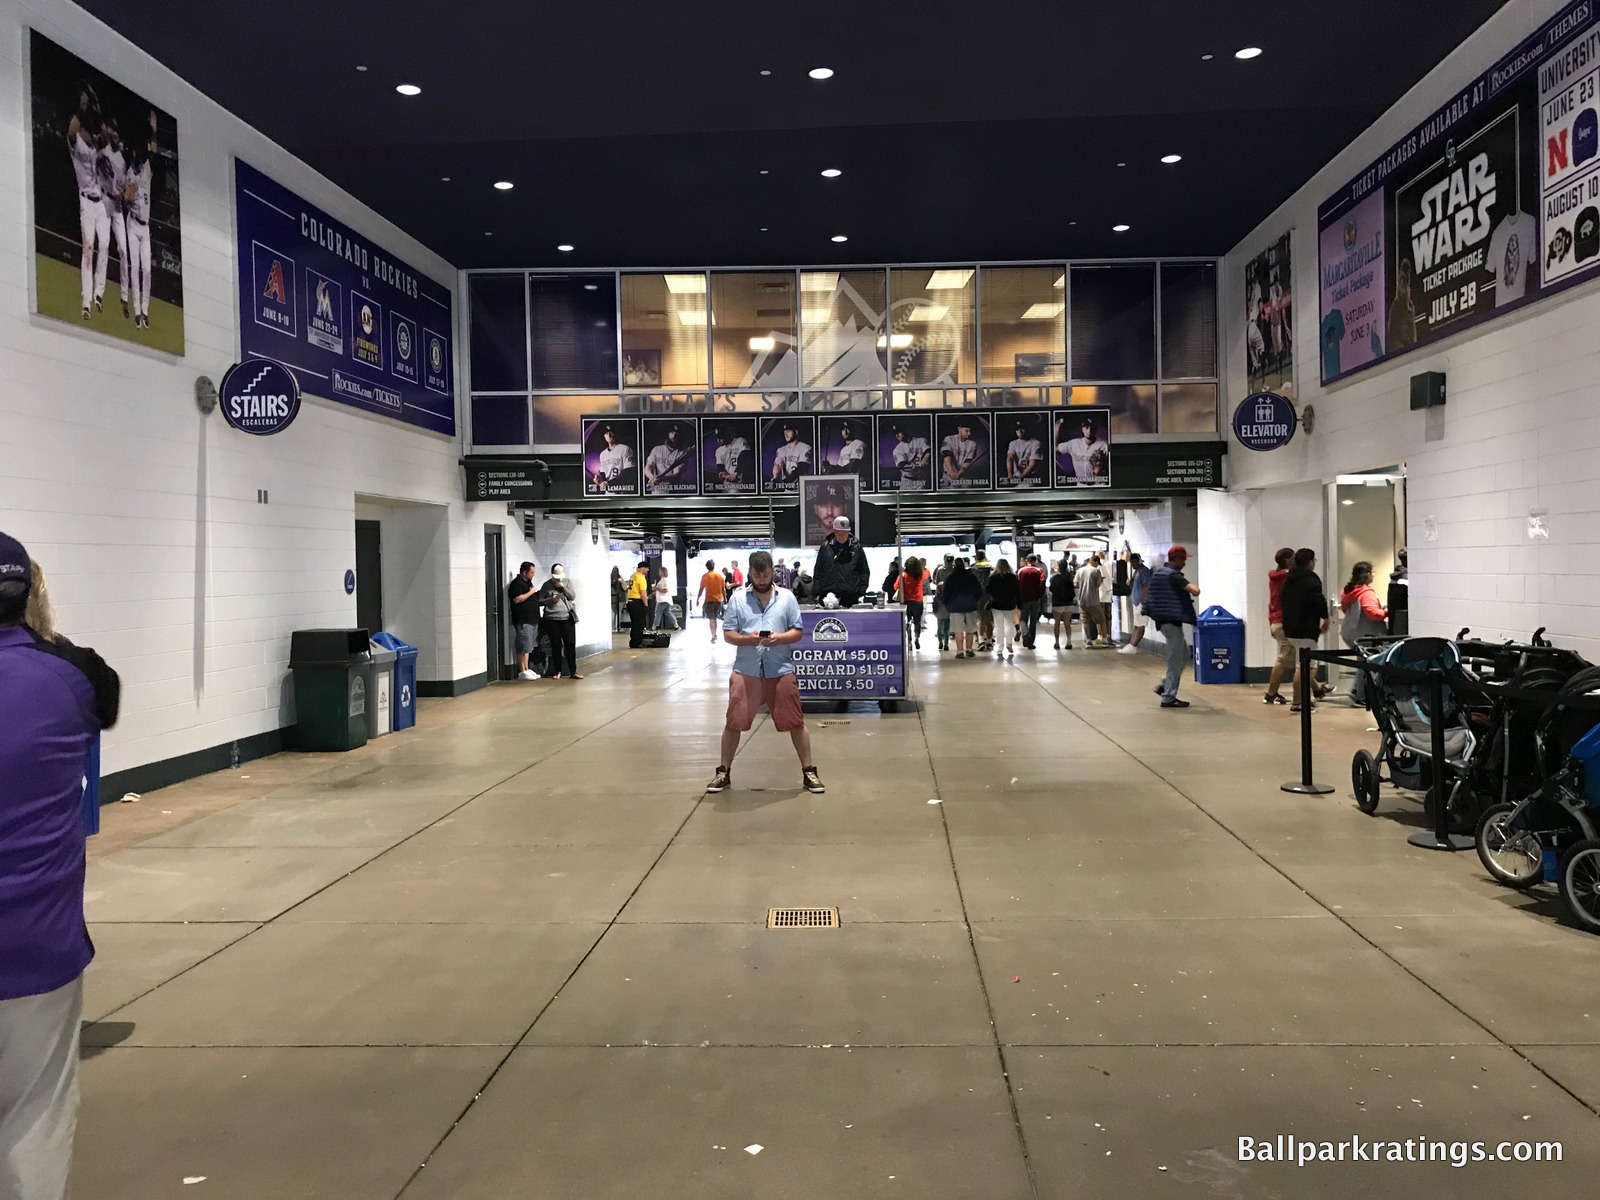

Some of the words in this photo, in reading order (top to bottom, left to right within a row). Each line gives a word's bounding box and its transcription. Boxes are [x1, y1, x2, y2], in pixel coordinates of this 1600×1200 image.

[1547, 90, 1574, 126] JUNE
[1580, 76, 1594, 104] 23
[1352, 169, 1375, 200] TICKET
[1378, 136, 1417, 180] PACKAGES
[1420, 94, 1469, 148] AVAILABLE
[1472, 81, 1485, 108] AT
[1412, 152, 1496, 238] STAR
[1546, 183, 1584, 222] AUGUST
[1588, 176, 1598, 200] 10
[1412, 190, 1496, 274] WARS
[302, 212, 368, 270] COLORADO
[374, 256, 418, 299] ROCKIES
[1423, 267, 1446, 292] TICKET
[1448, 249, 1483, 281] PACKAGE
[1332, 284, 1348, 304] Ticket
[1350, 271, 1374, 292] Package
[263, 307, 276, 321] JUNE
[1345, 299, 1374, 325] SATURDAY
[1428, 290, 1457, 324] JULY
[1460, 281, 1476, 310] 28
[313, 317, 324, 330] JUNE
[1350, 325, 1364, 344] JUNE
[231, 394, 288, 418] STAIRS
[1242, 424, 1288, 437] ELEVATOR
[815, 632, 848, 640] ROCKIES
[791, 650, 847, 661] OGRAM
[850, 650, 888, 661] $5.00
[794, 665, 856, 676] RECARD
[860, 664, 895, 676] $1.50
[798, 679, 842, 690] ENCIL
[845, 679, 874, 690] $.50
